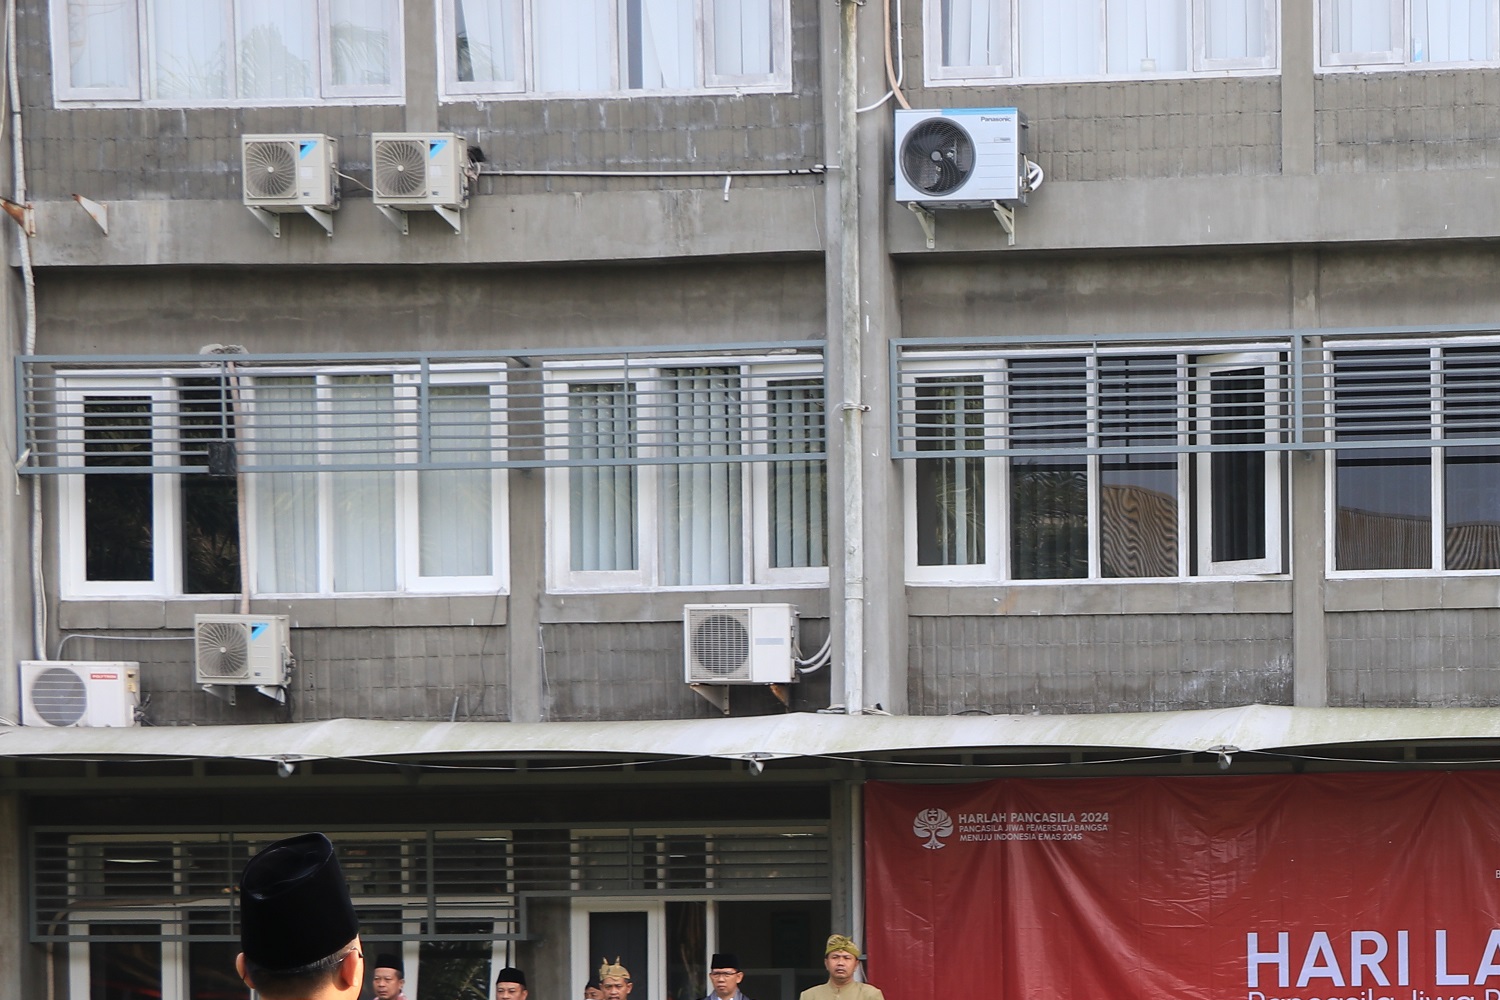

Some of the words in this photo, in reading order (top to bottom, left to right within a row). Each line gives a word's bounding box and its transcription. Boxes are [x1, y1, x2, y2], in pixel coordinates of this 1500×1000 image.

[958, 813, 1007, 824] HARLAH
[1010, 812, 1076, 824] PANCASILA
[1080, 812, 1109, 823] 2024
[958, 825, 1003, 833] PANCASILA
[1004, 824, 1025, 832] JIWA
[1026, 824, 1073, 832] PEMERSATU
[1074, 824, 1108, 832] BANGSA
[959, 833, 993, 842] MENUJU
[994, 833, 1037, 841] INDONESIA
[1038, 833, 1062, 841] EMAS
[1062, 833, 1083, 841] 2045
[1247, 931, 1410, 988] HARI
